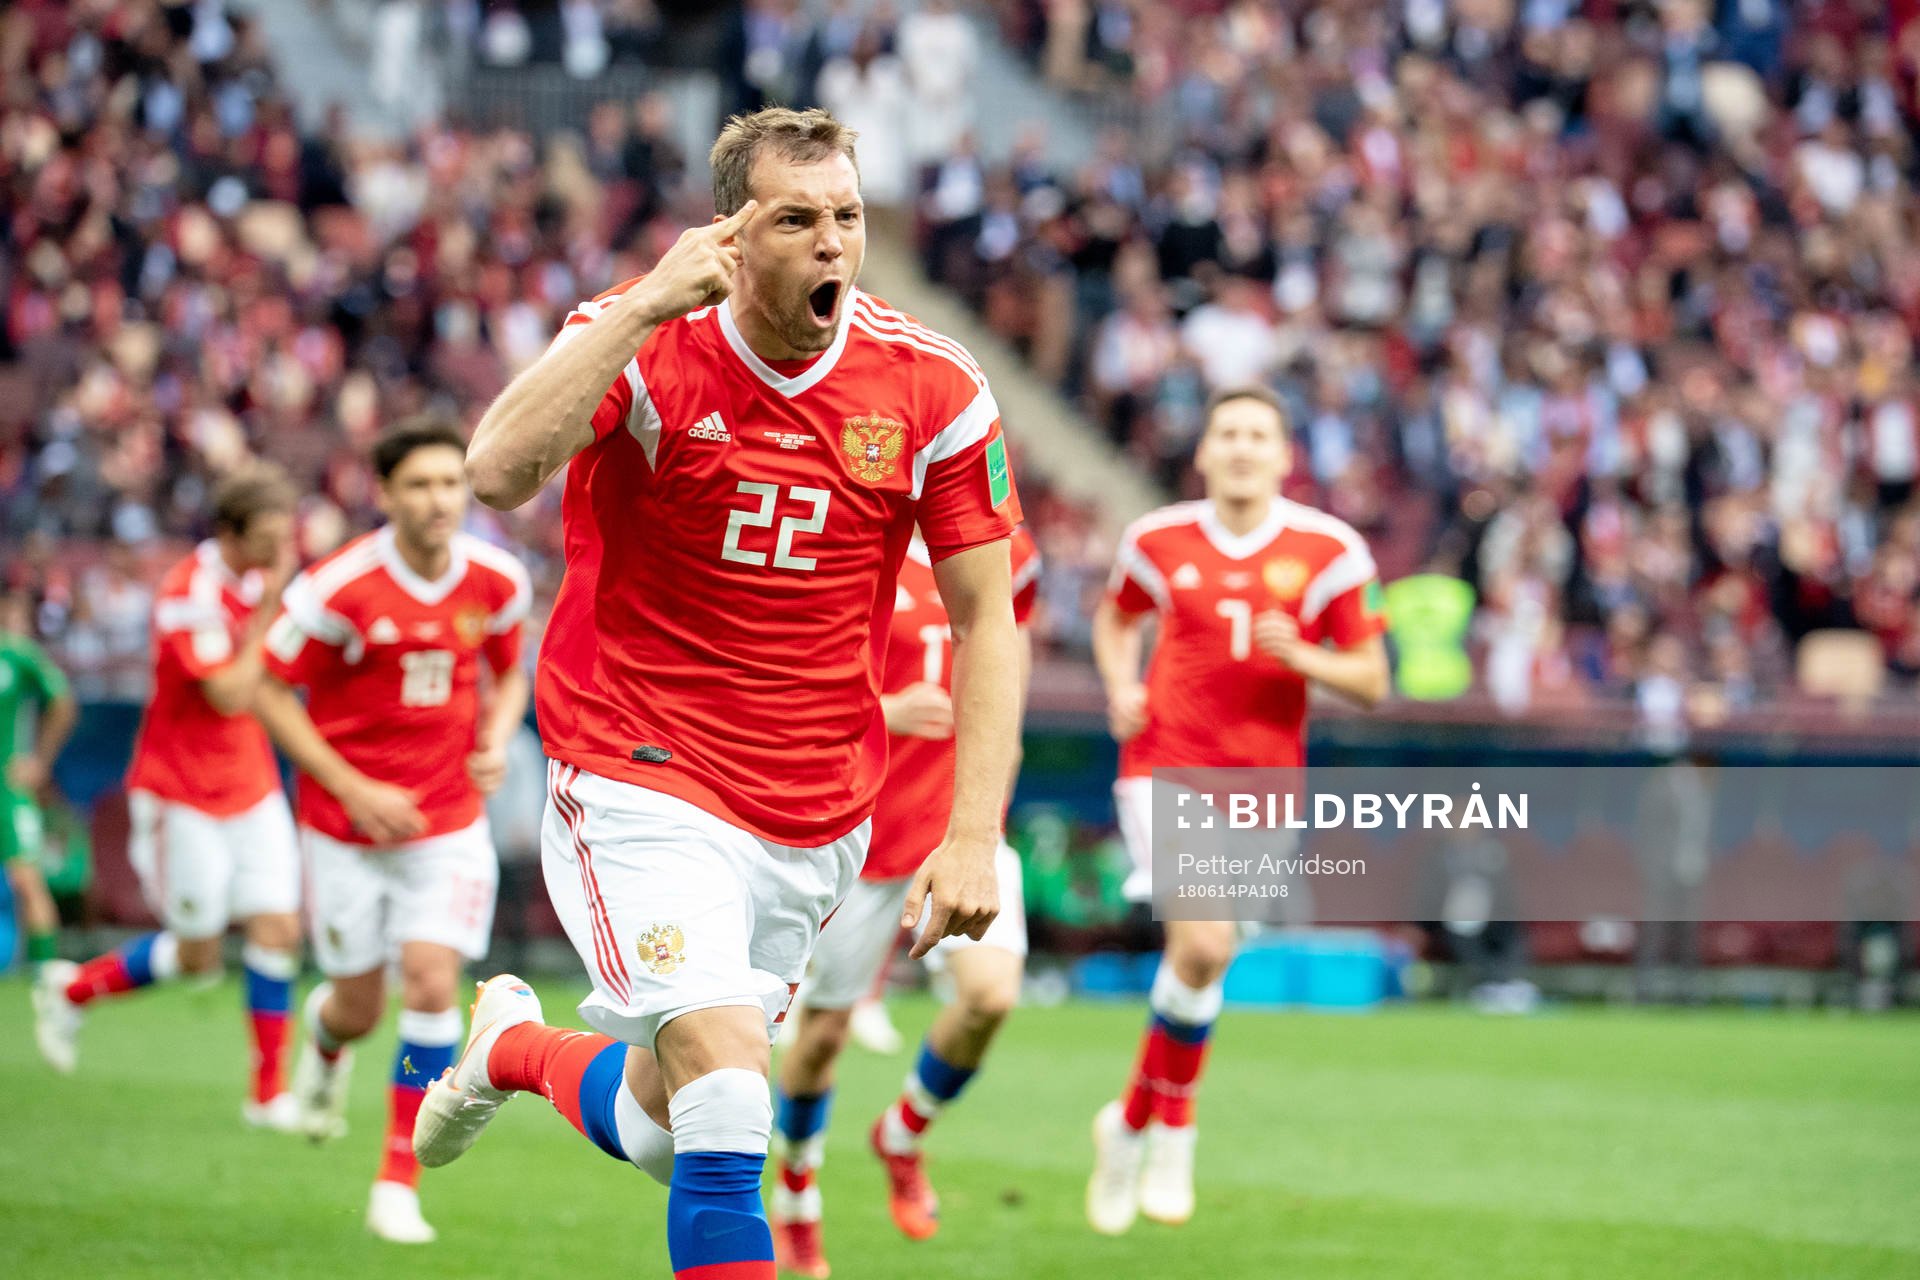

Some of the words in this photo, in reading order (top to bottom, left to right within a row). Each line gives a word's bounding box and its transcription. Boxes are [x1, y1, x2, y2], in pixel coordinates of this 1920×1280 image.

[687, 427, 732, 443] adidas
[721, 480, 832, 571] 22
[919, 624, 951, 684] 1
